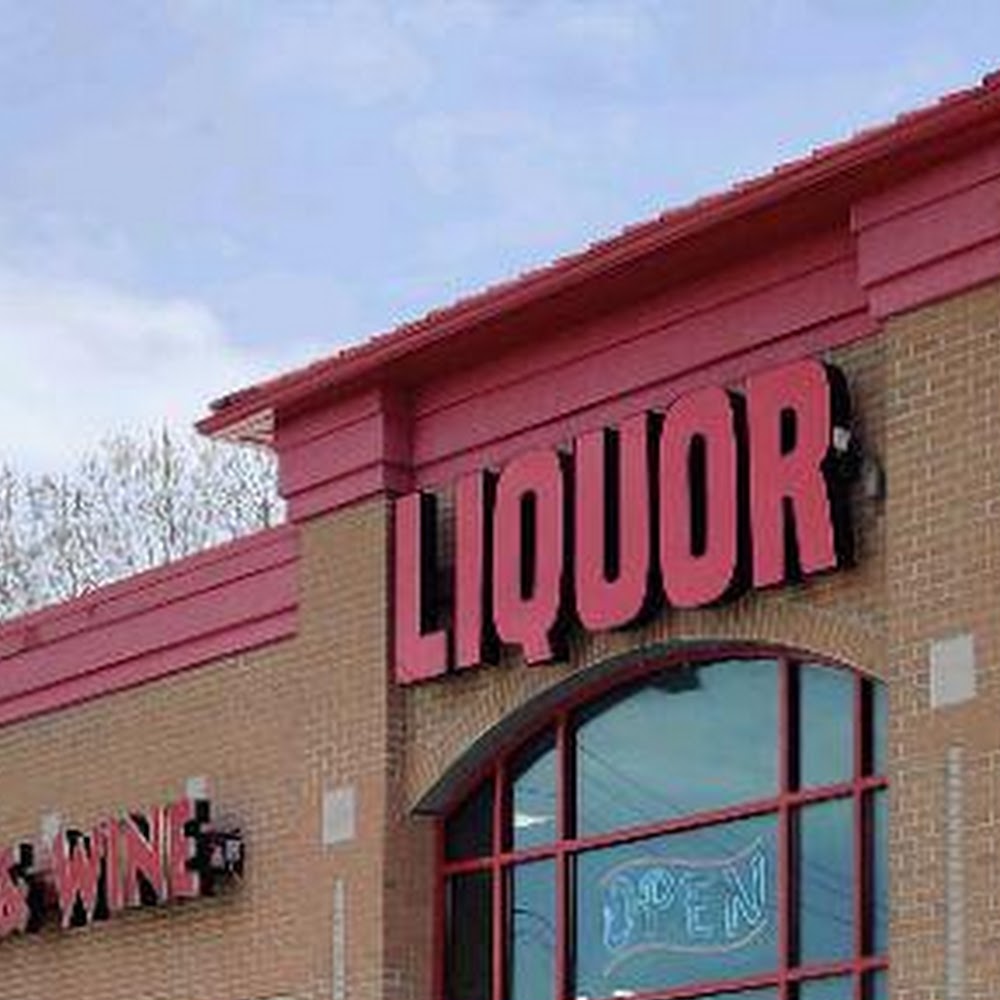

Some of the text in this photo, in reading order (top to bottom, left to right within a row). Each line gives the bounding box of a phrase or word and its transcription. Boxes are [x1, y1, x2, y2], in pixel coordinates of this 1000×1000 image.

[395, 357, 837, 685] LIQUOR
[52, 796, 200, 929] WINE
[603, 849, 765, 949] OPEN
